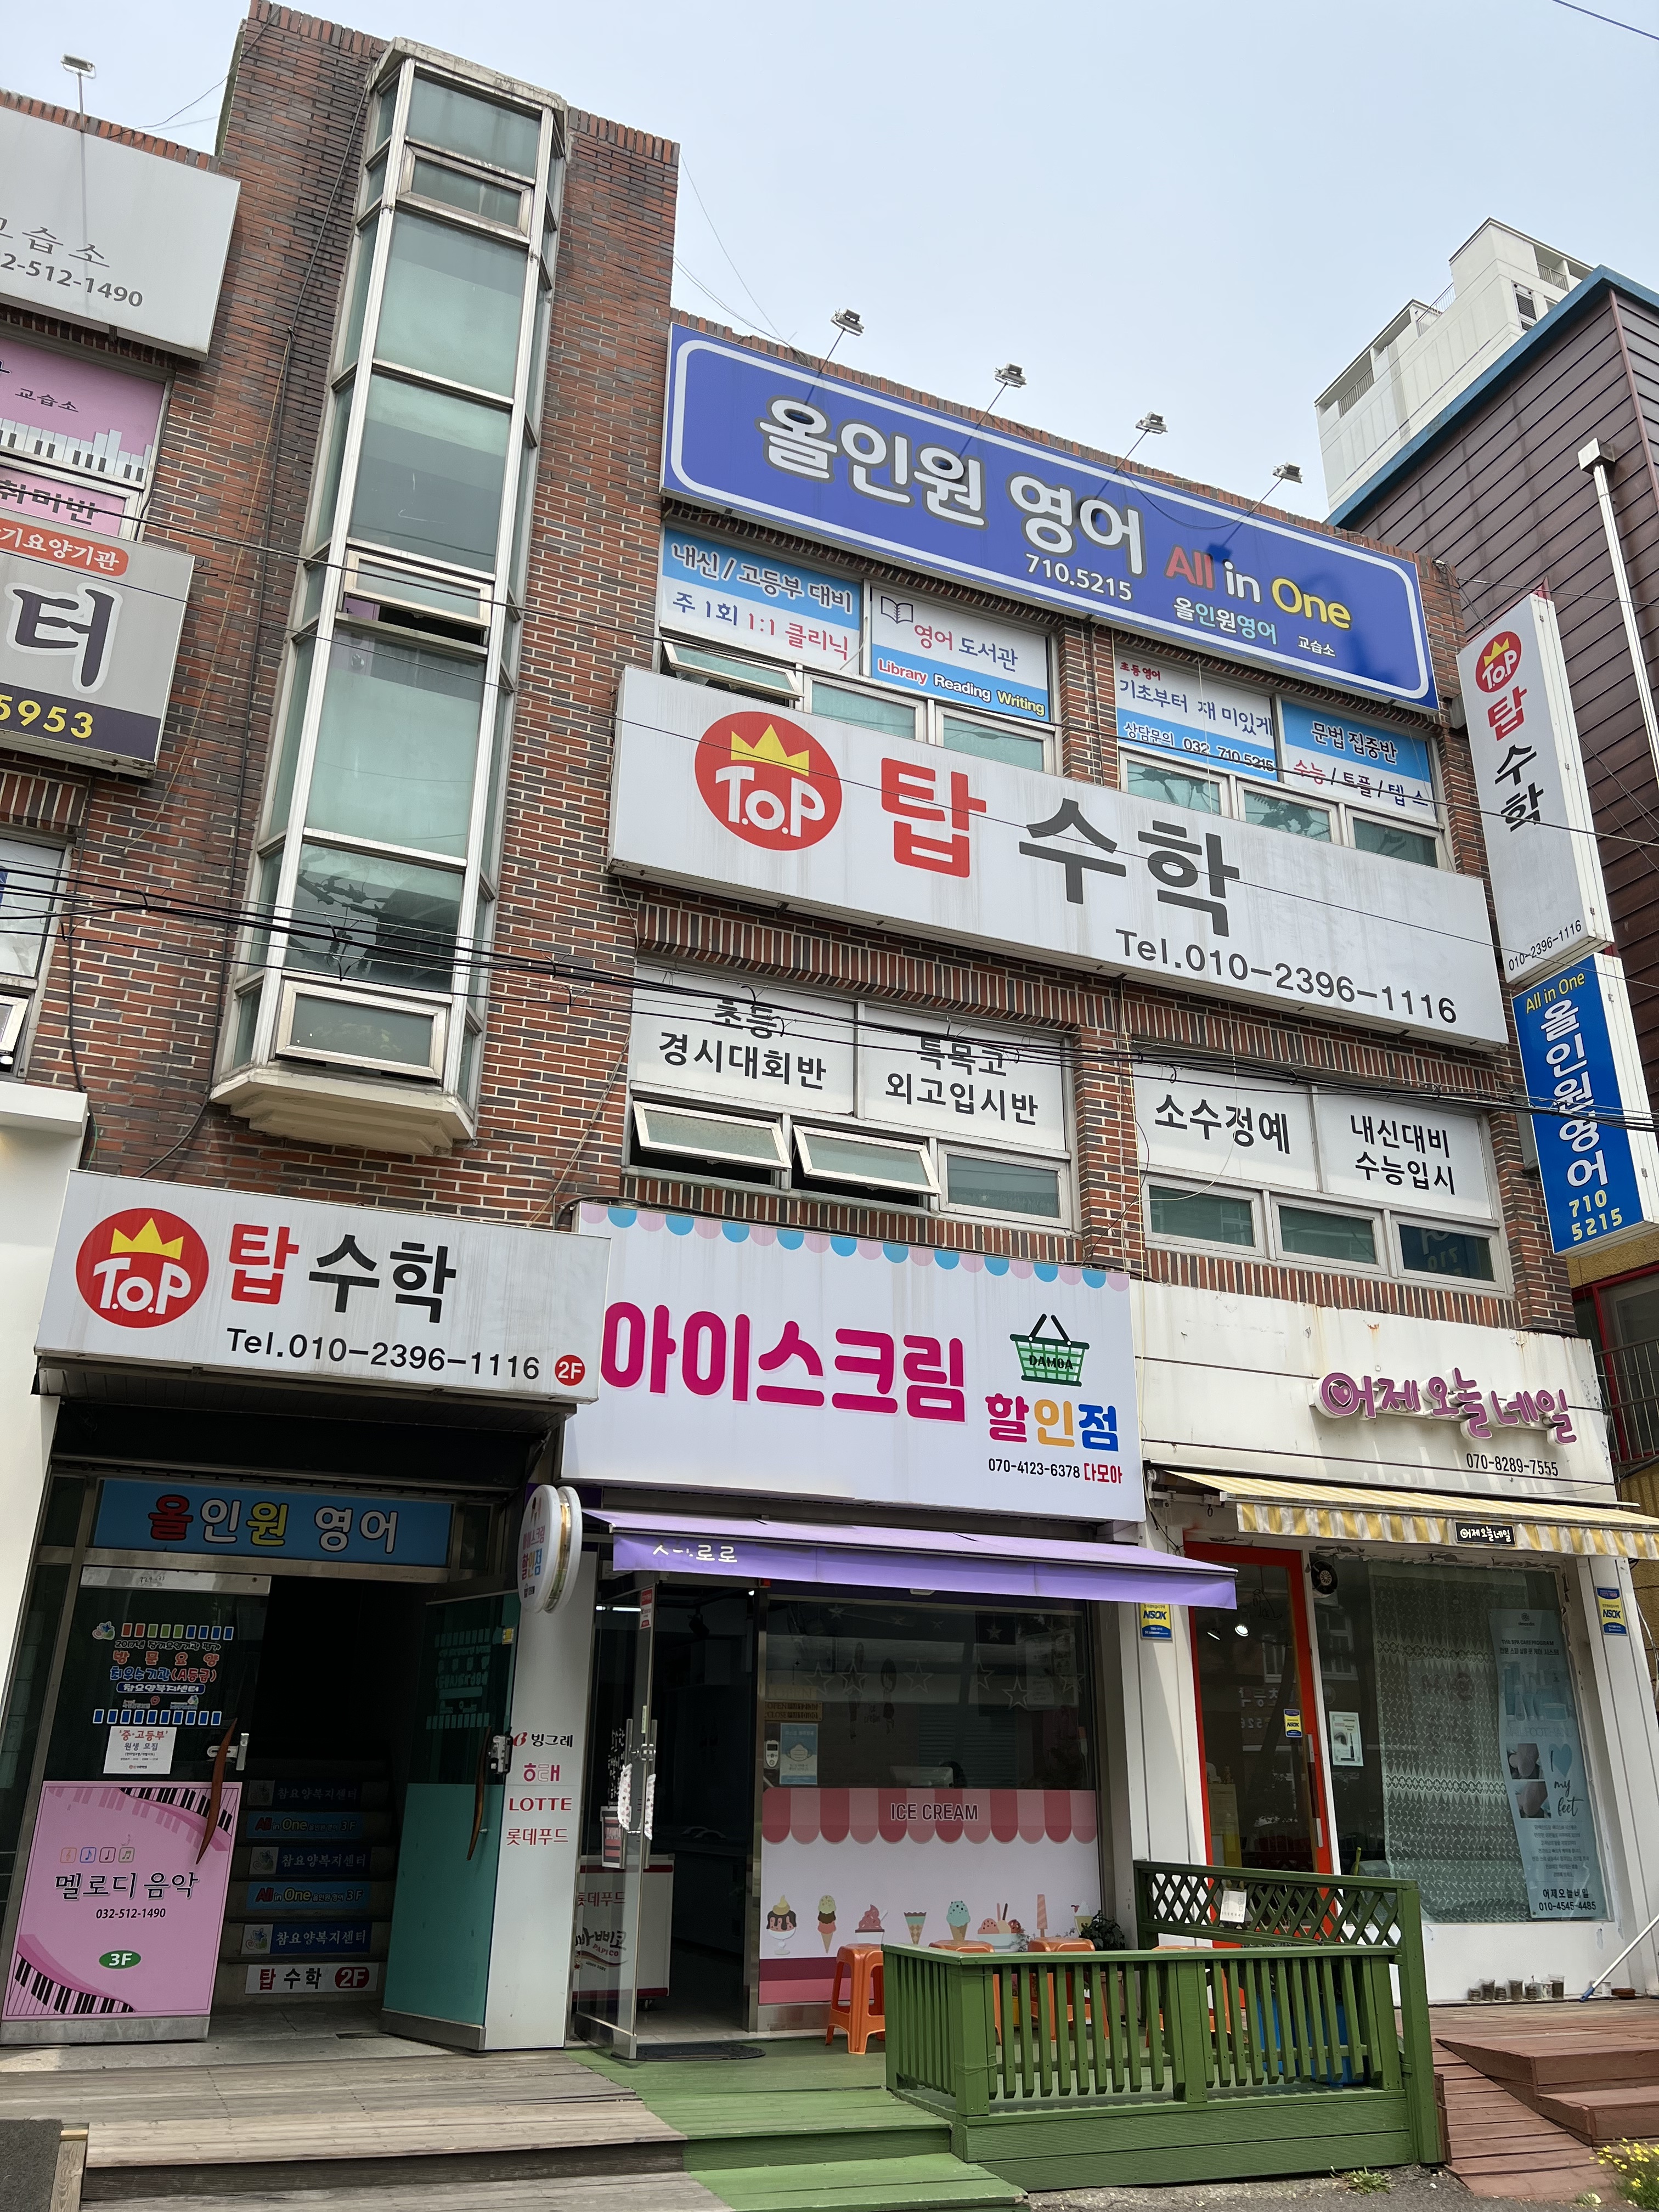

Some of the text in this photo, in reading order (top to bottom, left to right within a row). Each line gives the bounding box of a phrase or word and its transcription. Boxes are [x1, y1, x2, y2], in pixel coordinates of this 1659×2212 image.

[15, 387, 78, 413] 교습소
[0, 479, 99, 525] 취미반
[759, 399, 1144, 576] 올인원 영어
[0, 527, 120, 573] 기요양기관
[809, 584, 851, 613] 대비
[1026, 553, 1133, 601] 710.5215
[1166, 546, 1351, 629] All in One
[11, 587, 116, 689] 터
[673, 591, 848, 661] 주 1회 1:1 클리닉
[1173, 597, 1336, 657] 올인원영어 교습소
[914, 624, 1018, 672] 영어 도서관
[878, 659, 1046, 716] Library Reading Writing
[1120, 679, 1188, 713] 기초부터
[1487, 685, 1527, 741] 탑
[1125, 723, 1174, 746] 상담문의
[1183, 738, 1210, 756] 032
[1312, 722, 1397, 764] 문법 집중반
[881, 757, 1240, 938] 탑 수학
[1508, 919, 1583, 972] 010-2396-1116
[1115, 928, 1458, 1024] Tel.010-2396-1116
[1525, 972, 1585, 1015] All in One
[711, 998, 777, 1040] 초등
[658, 1031, 827, 1091] 경시대회반
[884, 1073, 1039, 1126] 외고입시반
[1154, 1094, 1290, 1154] 소수정예
[1350, 1114, 1451, 1159] 내신대비
[1354, 1151, 1455, 1195] 수능입시
[1569, 1189, 1607, 1218] 710
[1571, 1207, 1623, 1242] 5215
[228, 1223, 457, 1324] 탑 수학
[226, 1327, 582, 1381] Tel.010-2396-1116 2F
[600, 1301, 966, 1423] 아이스크림
[1029, 1355, 1074, 1370] DAMOA
[985, 1393, 1120, 1452] 할인점
[988, 1458, 1081, 1479] 070-4123-6378
[1084, 1462, 1123, 1485] 다모아
[1466, 1453, 1559, 1477] 070-8289-7555
[148, 1494, 399, 1554] 올인원 영어
[531, 1733, 574, 1748] 빙그레
[509, 1797, 572, 1812] LOTTE
[1554, 1779, 1571, 1797] my
[1557, 1796, 1584, 1817] feet
[890, 1803, 979, 1821] ICE CREAM
[505, 1827, 569, 1846] 롯데푸드
[55, 1871, 200, 1900] 멜로디 음악
[1538, 1900, 1597, 1912] 010-4545-4485
[95, 1908, 166, 1920] 032-512-1490
[109, 1953, 133, 1967] 3F
[259, 1967, 276, 1991] 탑
[339, 1968, 366, 1988] 2F
